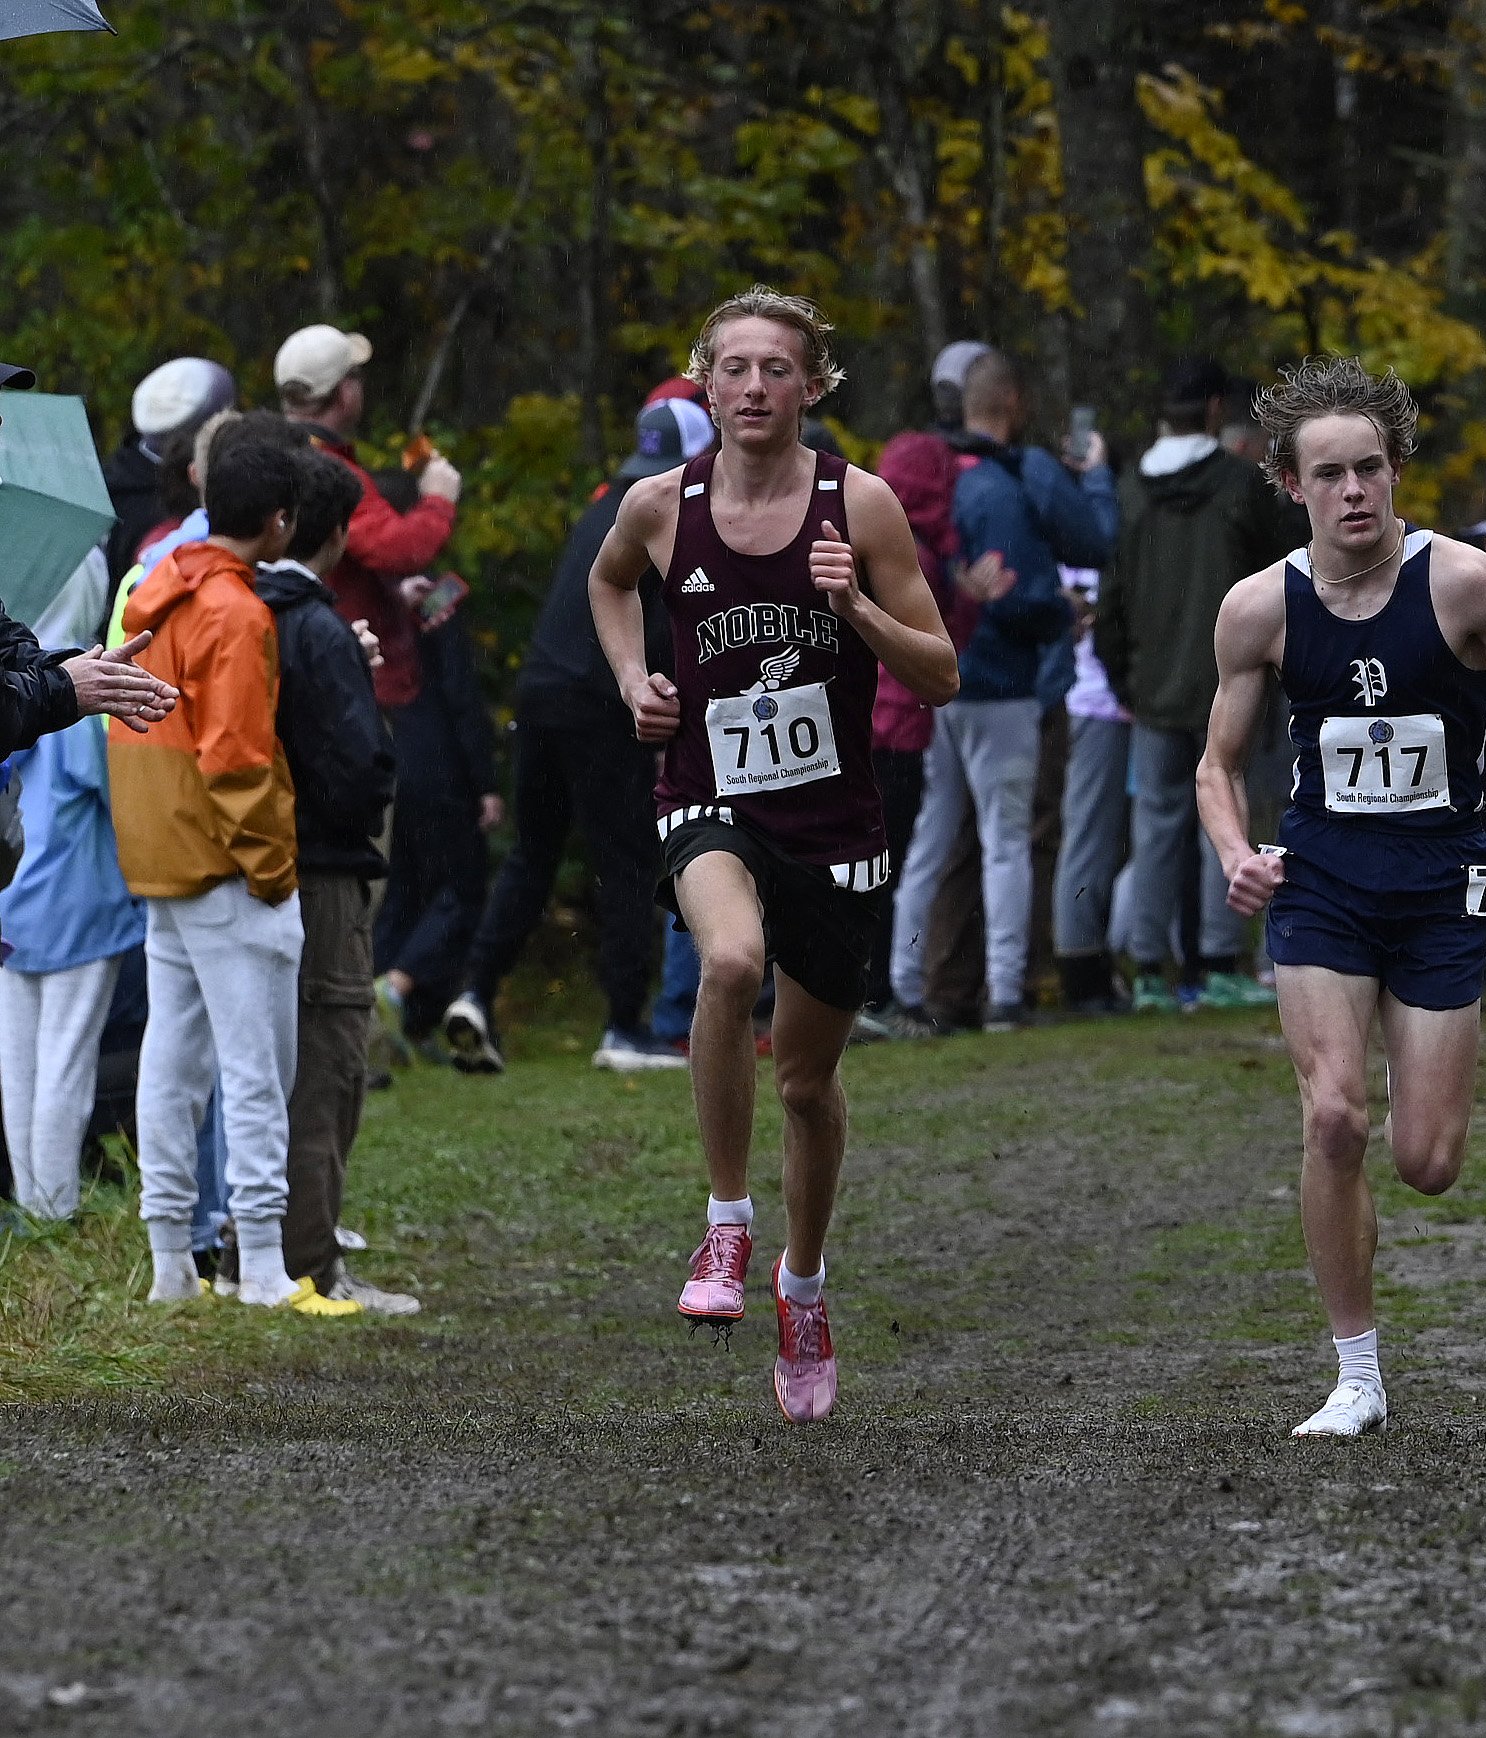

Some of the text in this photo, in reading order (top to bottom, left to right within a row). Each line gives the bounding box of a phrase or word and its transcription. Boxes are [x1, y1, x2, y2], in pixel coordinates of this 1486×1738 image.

[681, 583, 715, 593] adidas
[697, 603, 838, 664] NOBLE
[1349, 657, 1388, 706] P
[723, 716, 819, 769] 710
[726, 758, 829, 785] South Regional Championship
[1336, 746, 1428, 788] 717
[1336, 787, 1439, 805] South Regional Championship
